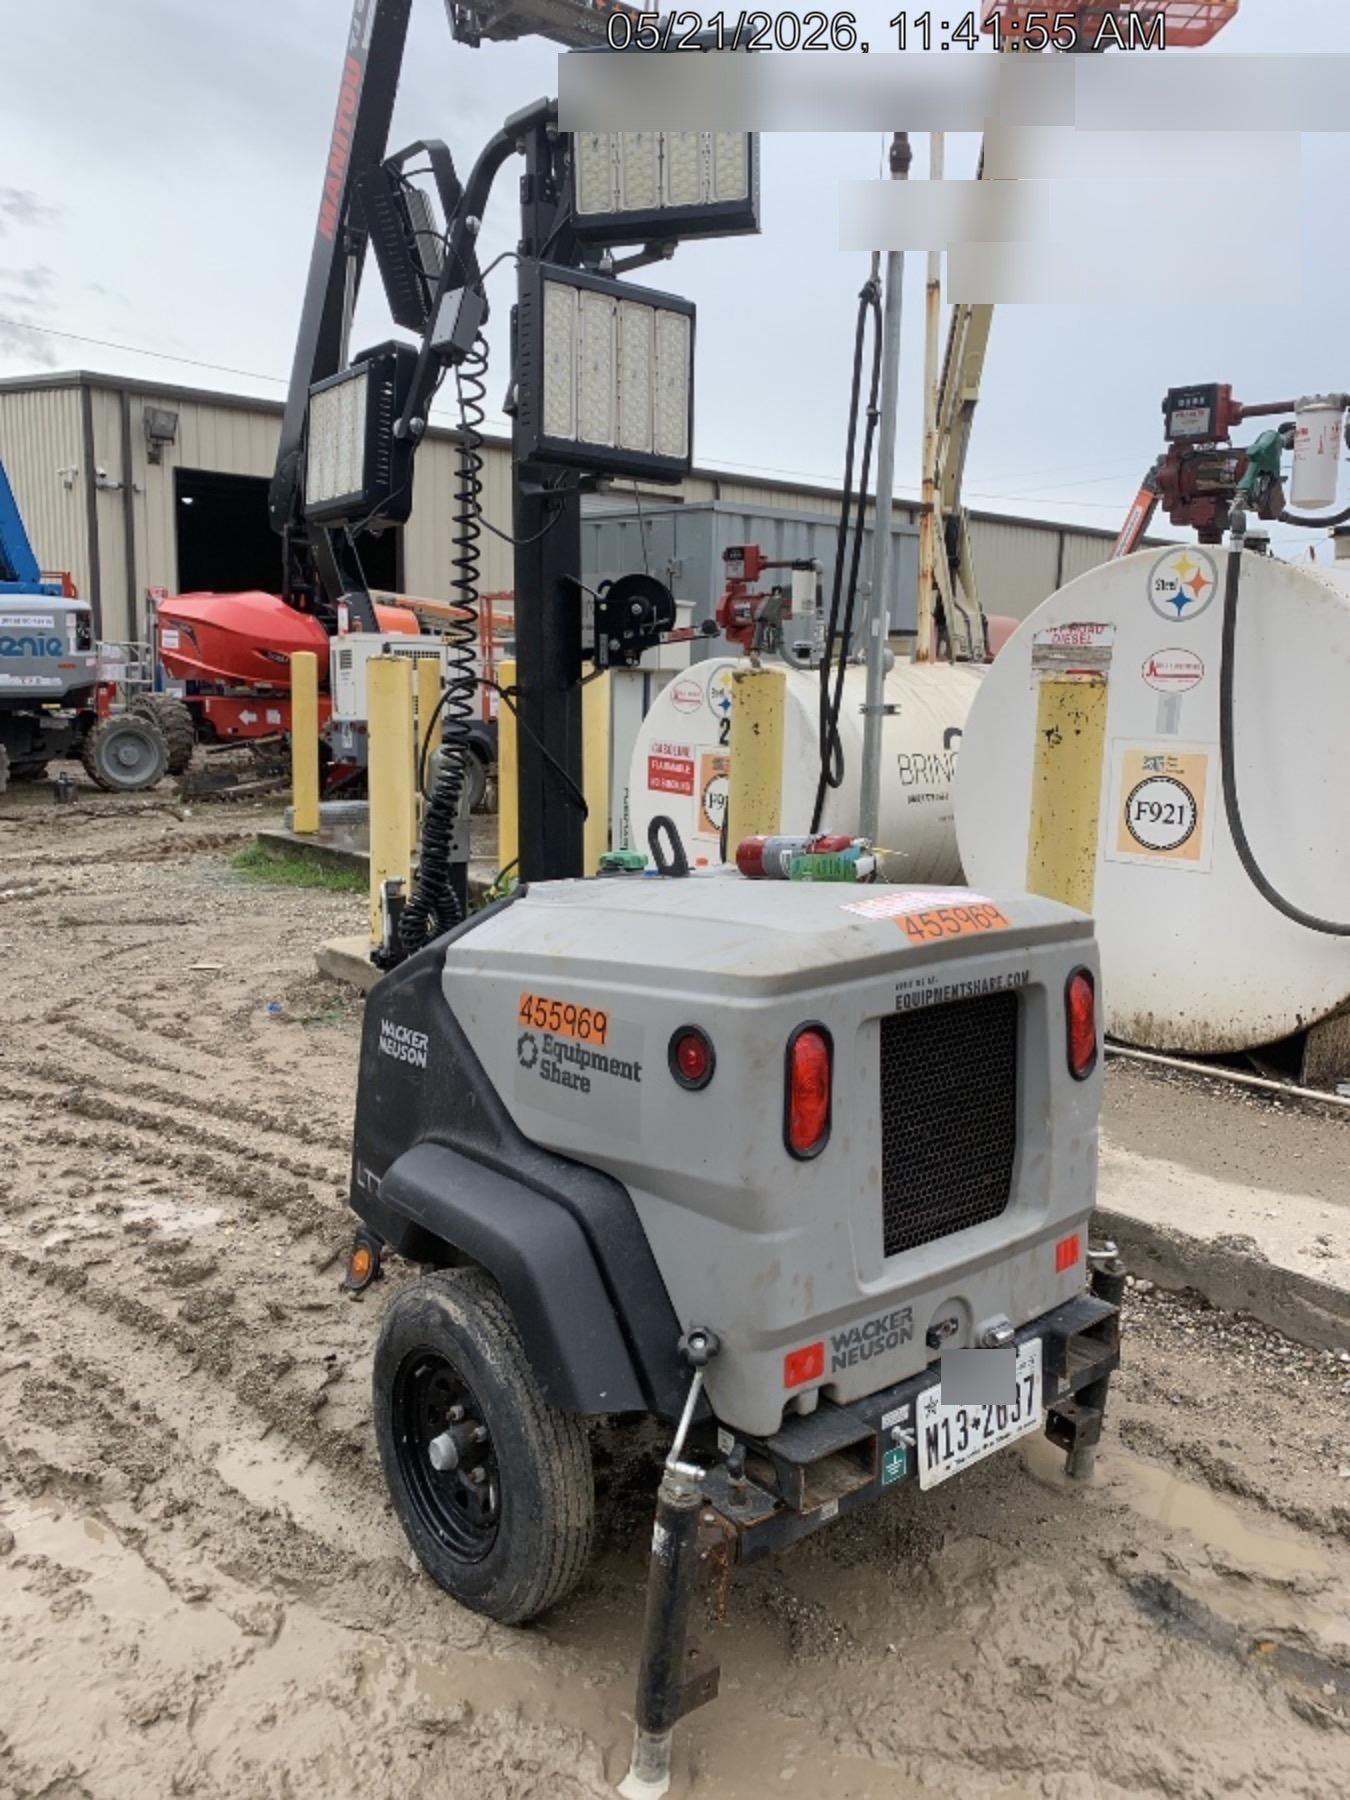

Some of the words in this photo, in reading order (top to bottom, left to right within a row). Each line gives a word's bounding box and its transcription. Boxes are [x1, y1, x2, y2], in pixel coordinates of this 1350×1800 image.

[319, 57, 362, 241] MANITOU
[1134, 800, 1185, 825] F921
[905, 903, 1010, 939] 455969
[896, 970, 1030, 1011] EQUIPMENTSHARE.COM
[381, 1018, 429, 1050] WACKER
[519, 995, 607, 1045] 455969
[379, 1035, 428, 1069] NEUSON
[541, 1033, 642, 1082] Equipment
[539, 1059, 591, 1094] Share
[830, 1307, 913, 1352] WACKER
[831, 1325, 913, 1373] NEUSON
